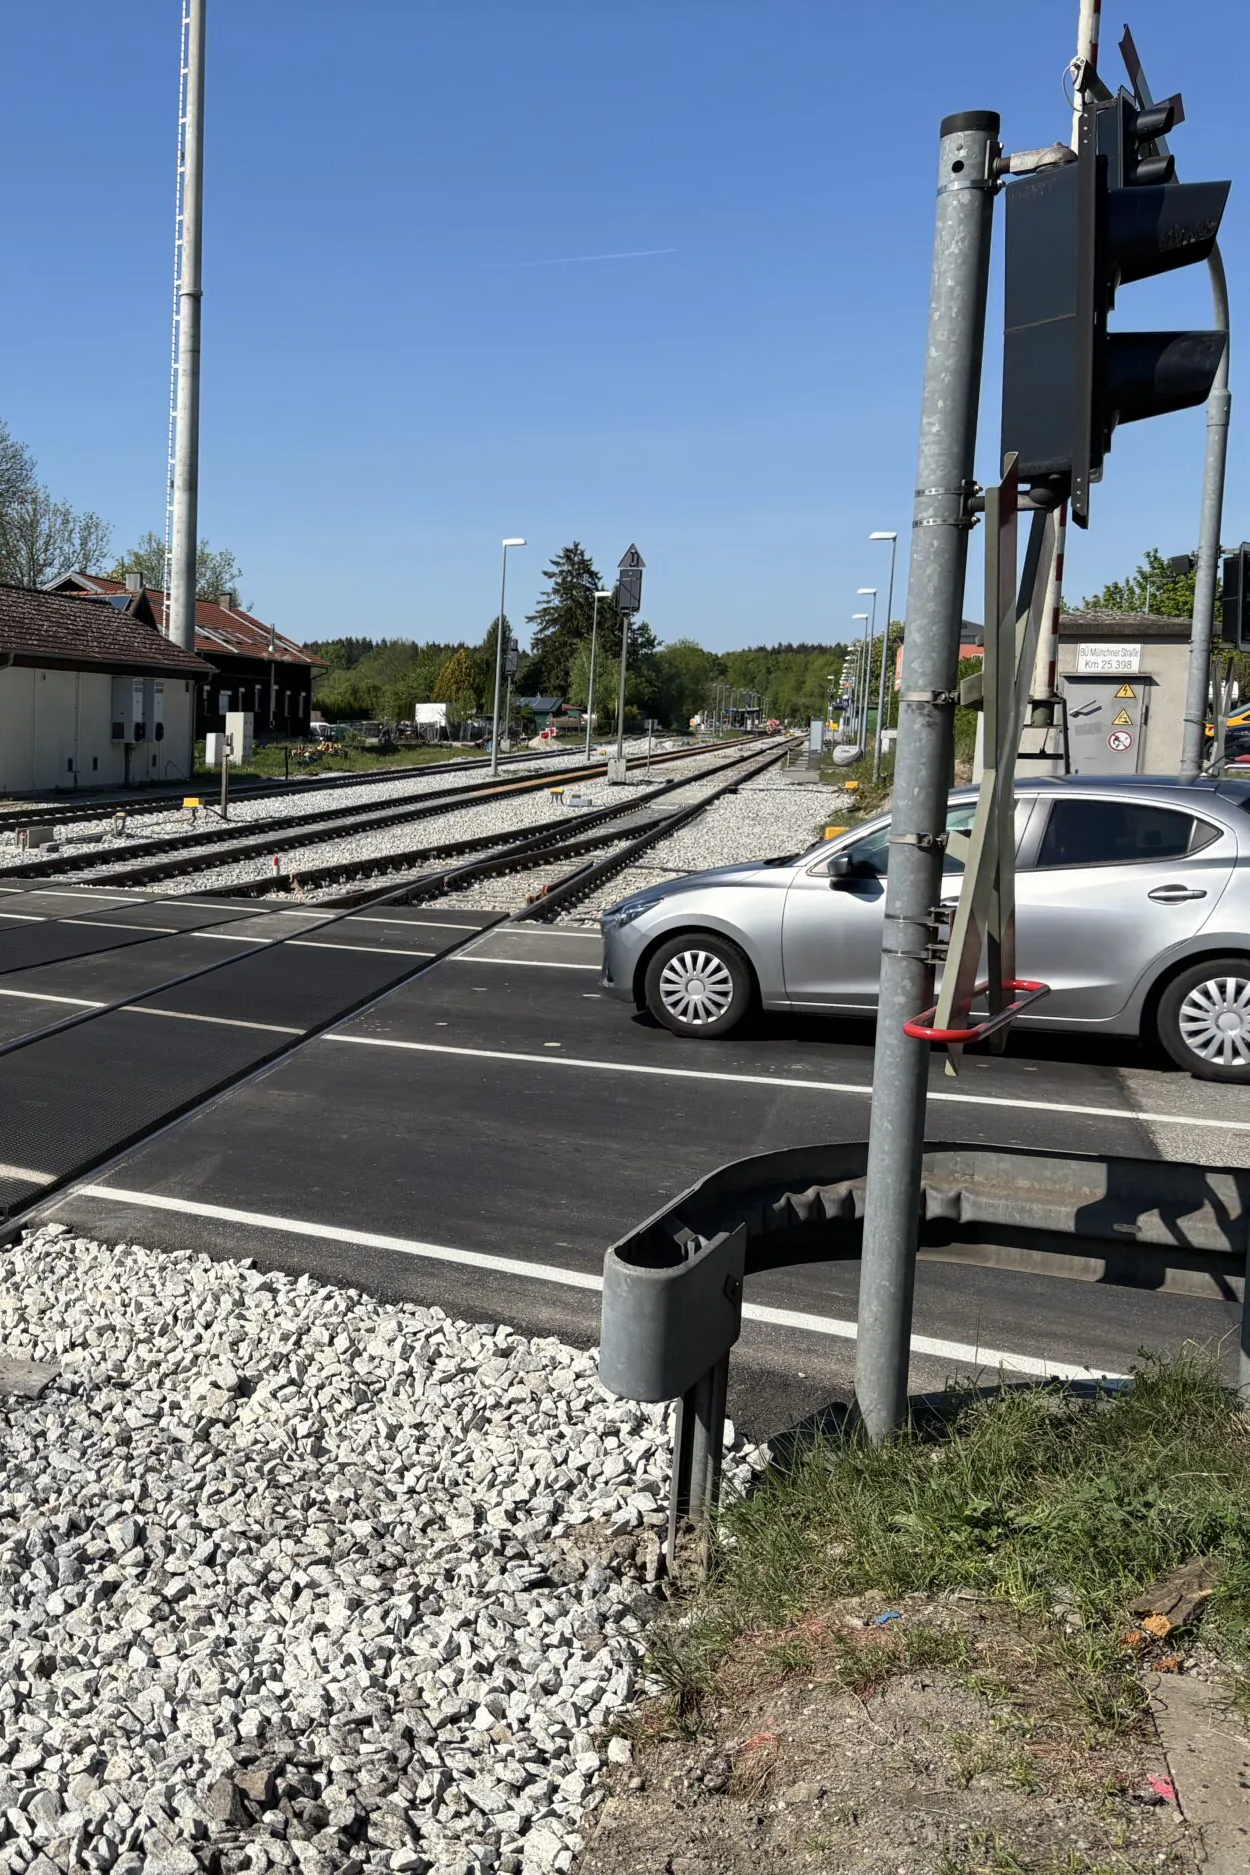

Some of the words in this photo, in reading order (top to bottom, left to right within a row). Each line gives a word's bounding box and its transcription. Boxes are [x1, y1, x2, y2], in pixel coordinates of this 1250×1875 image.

[1090, 646, 1120, 658] Münchner
[1121, 647, 1139, 658] Straße
[1085, 659, 1099, 669] Km
